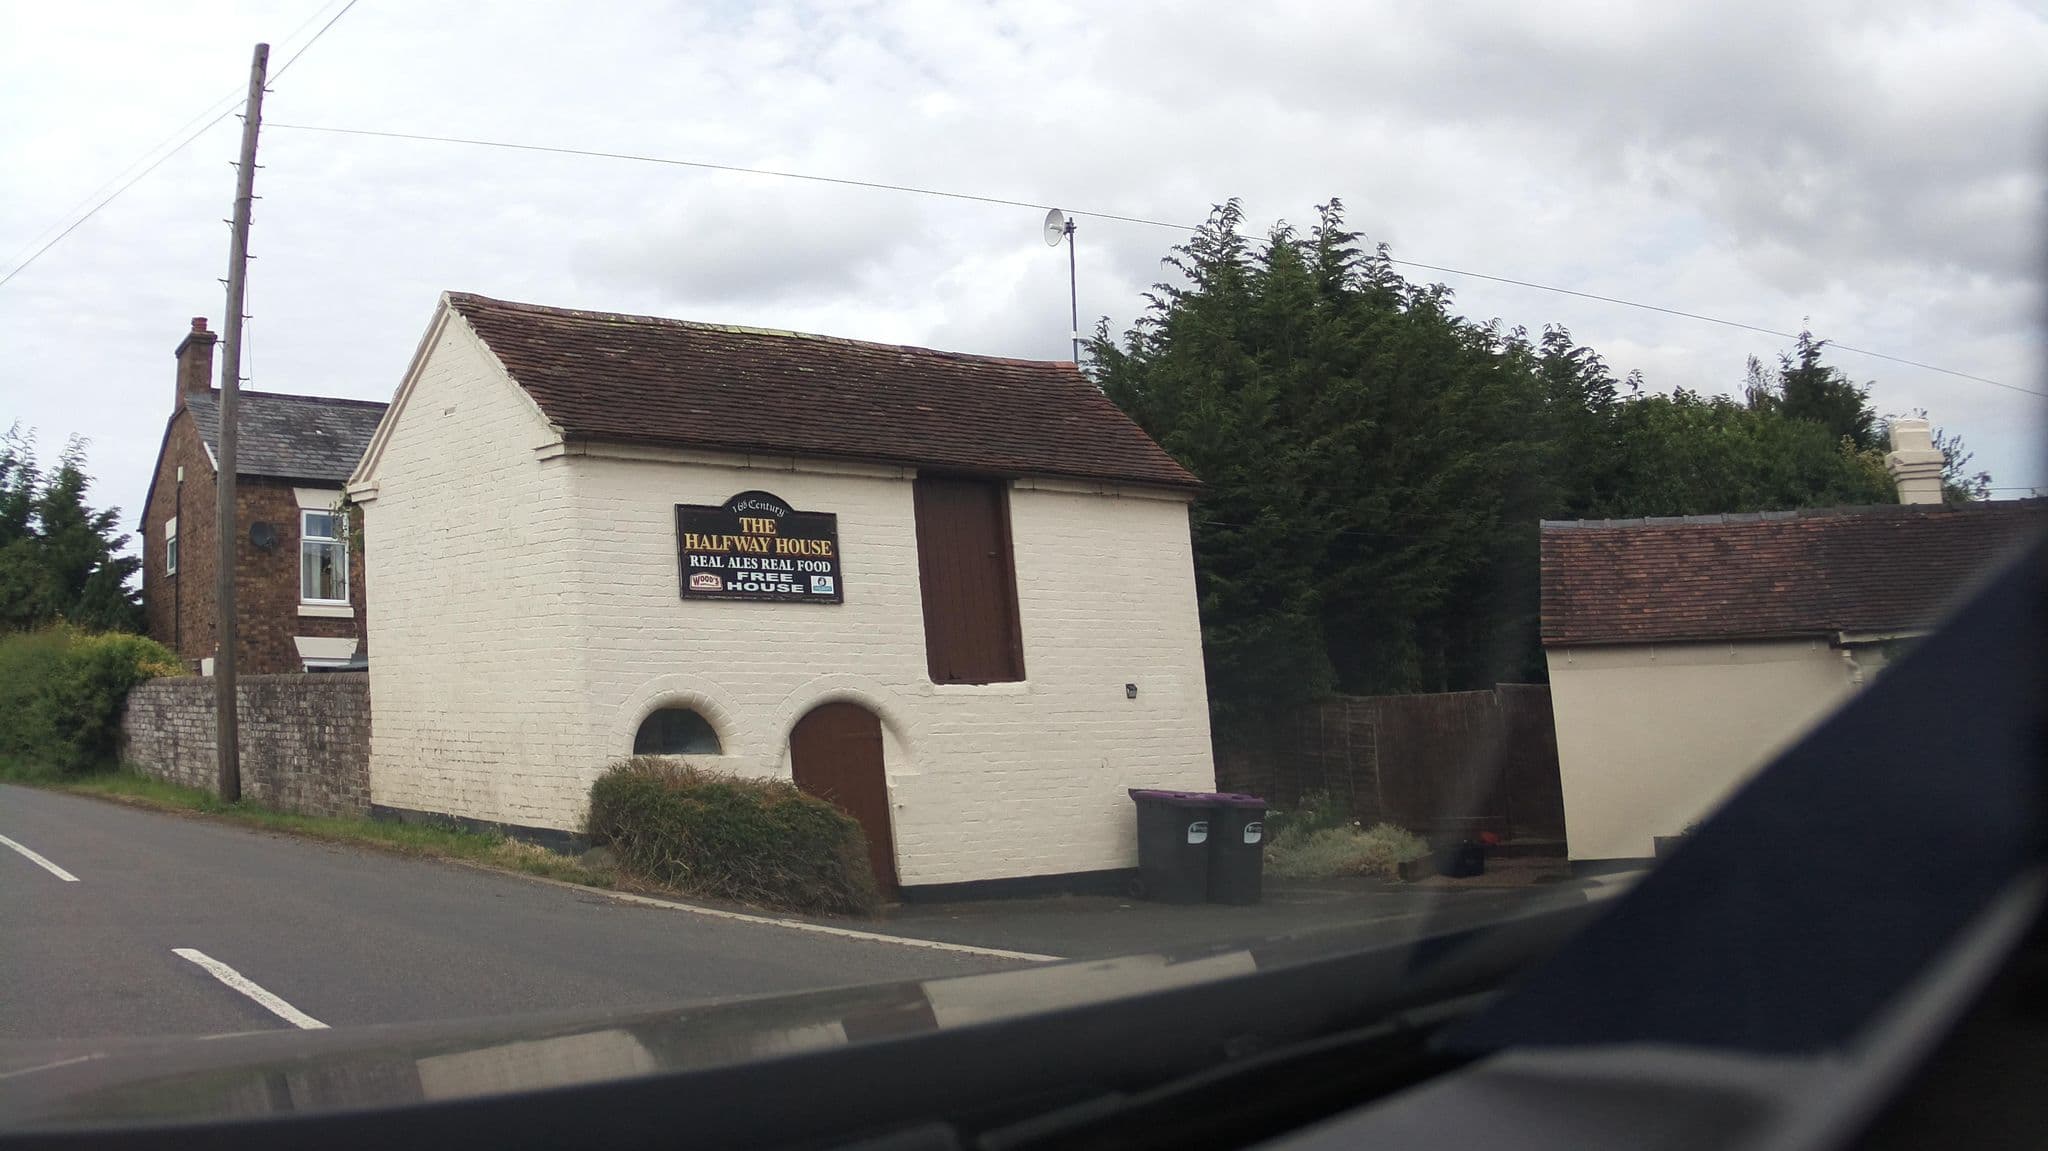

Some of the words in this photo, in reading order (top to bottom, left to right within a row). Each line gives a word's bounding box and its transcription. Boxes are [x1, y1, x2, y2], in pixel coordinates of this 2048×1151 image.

[749, 500, 785, 517] Century
[739, 517, 776, 534] THE
[684, 533, 771, 553] HALFWAY
[775, 538, 832, 555] HOUSE
[690, 555, 724, 568] REAL
[728, 557, 758, 569] ALES
[761, 558, 794, 571] REAL
[797, 560, 831, 572] FOOD
[693, 576, 719, 586] WOOD'S
[737, 572, 793, 582] FREE
[727, 581, 804, 593] HOUSE
